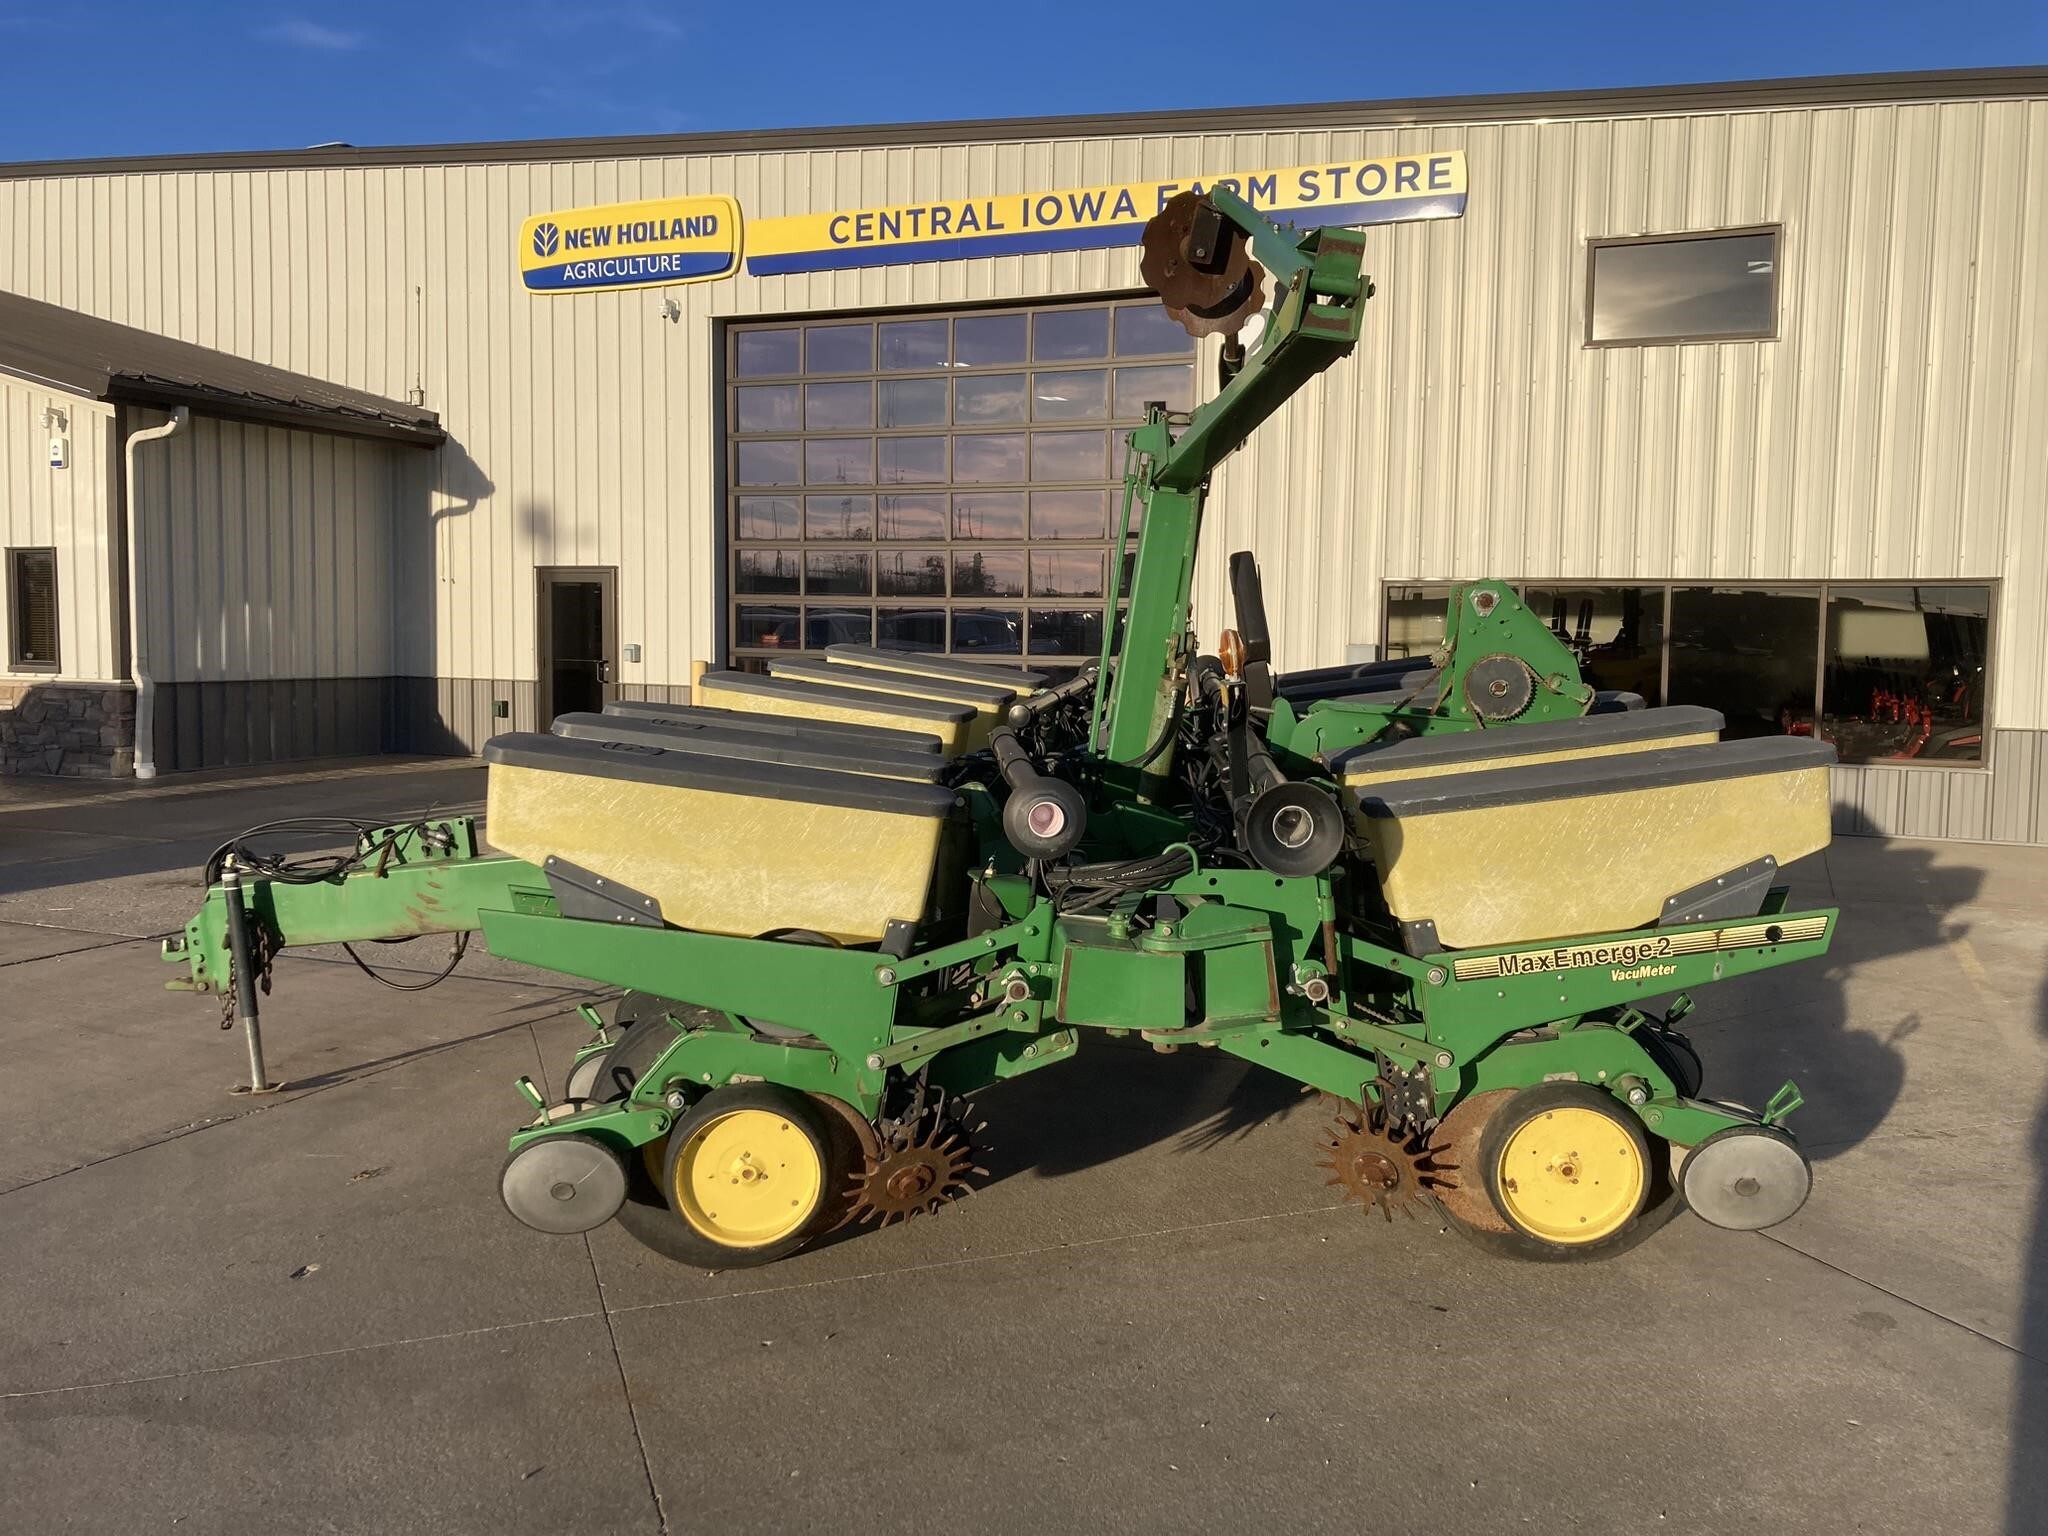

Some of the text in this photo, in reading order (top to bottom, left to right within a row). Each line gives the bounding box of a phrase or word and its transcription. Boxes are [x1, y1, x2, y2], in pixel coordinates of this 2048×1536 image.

[829, 202, 1005, 244] CENTRAL
[1022, 188, 1138, 227] IOWA
[1298, 156, 1454, 202] STORE
[565, 214, 718, 250] NEW HOLLAND
[563, 254, 681, 281] AGRICULTURE
[1610, 963, 1678, 982] VacuMeter
